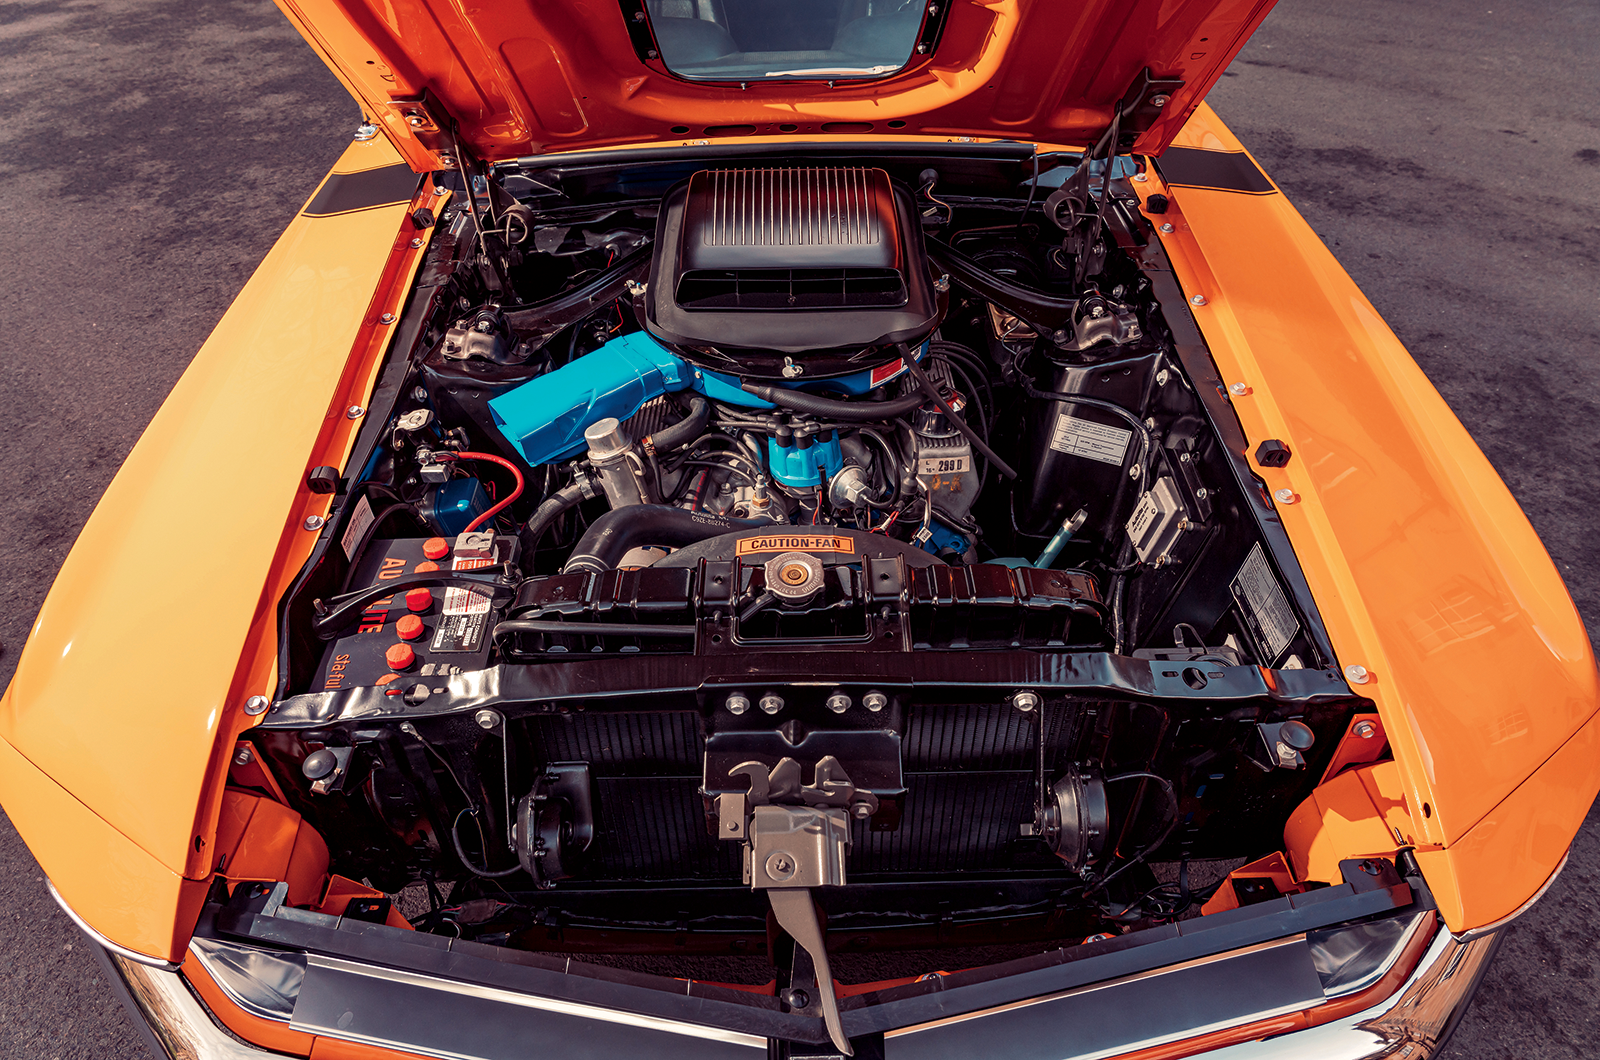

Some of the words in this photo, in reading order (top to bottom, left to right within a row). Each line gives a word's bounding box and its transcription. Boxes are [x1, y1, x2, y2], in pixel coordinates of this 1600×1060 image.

[938, 460, 955, 471] 299
[957, 459, 963, 470] D
[751, 538, 841, 549] CAUTION-FAN
[358, 557, 407, 633] AULITE
